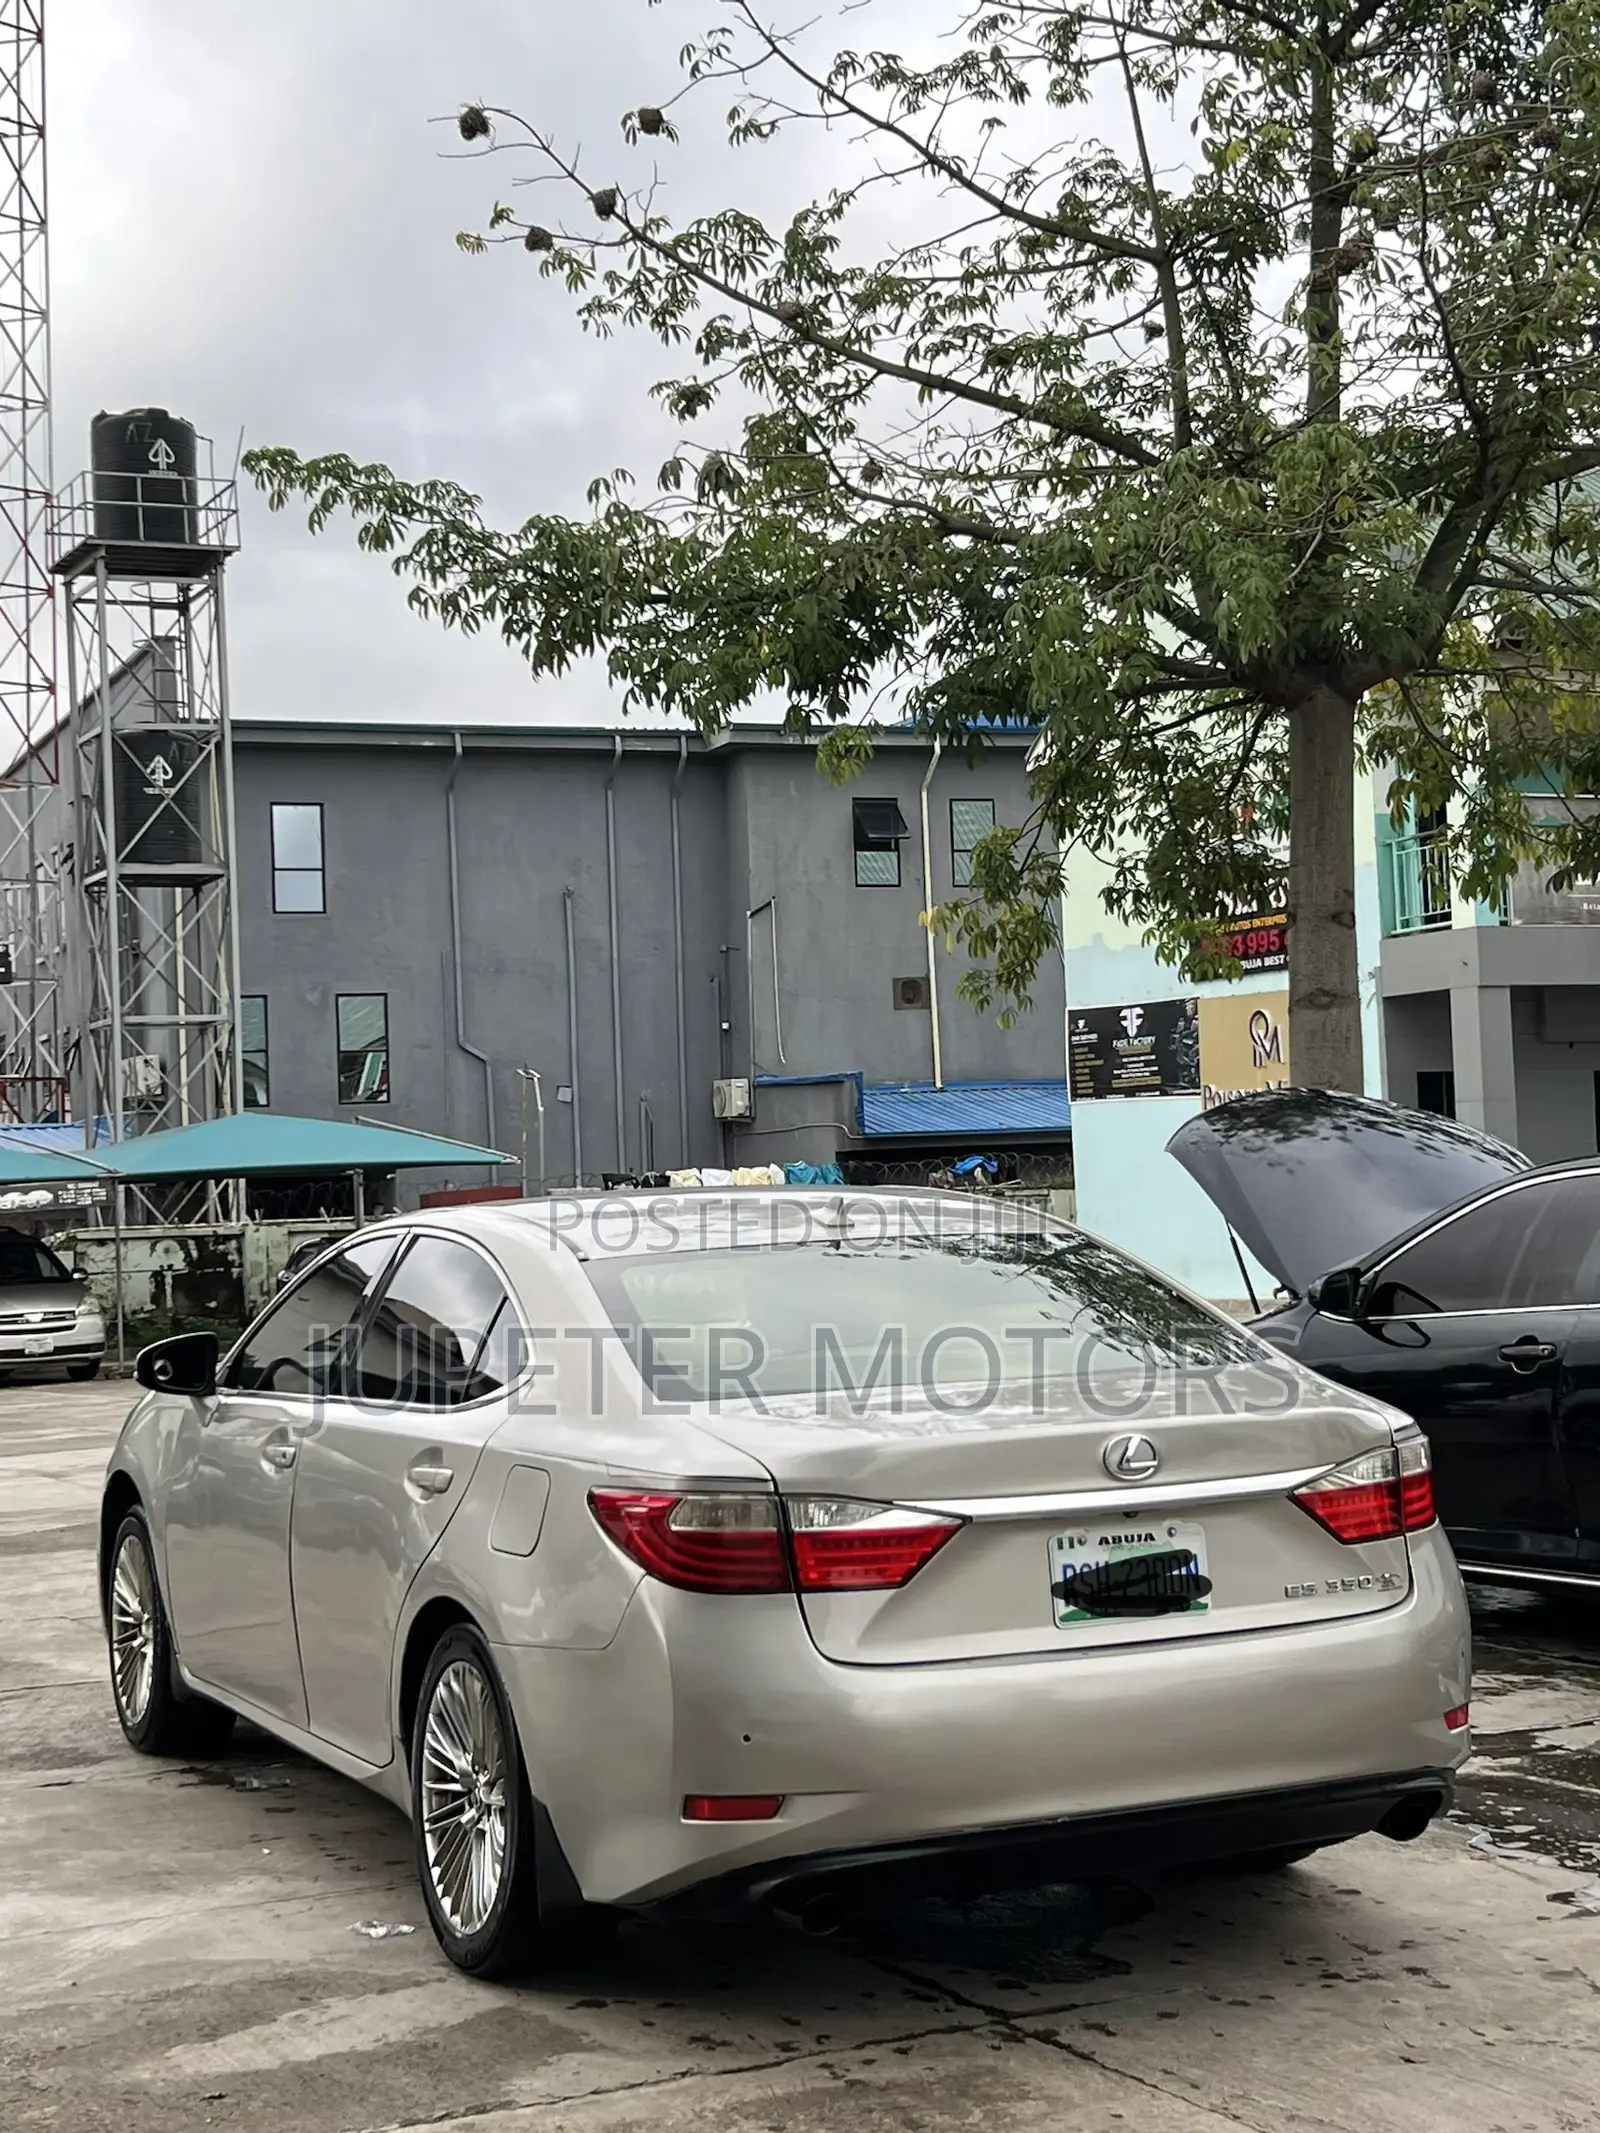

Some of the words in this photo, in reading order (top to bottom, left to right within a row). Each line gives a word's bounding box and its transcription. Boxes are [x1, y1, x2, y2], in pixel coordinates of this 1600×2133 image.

[1253, 914, 1288, 928] ENTERPRIS
[1264, 954, 1286, 967] BEST
[1098, 1532, 1156, 1546] ABUJA
[1284, 1581, 1317, 1598] ES
[1325, 1574, 1374, 1595] 350
